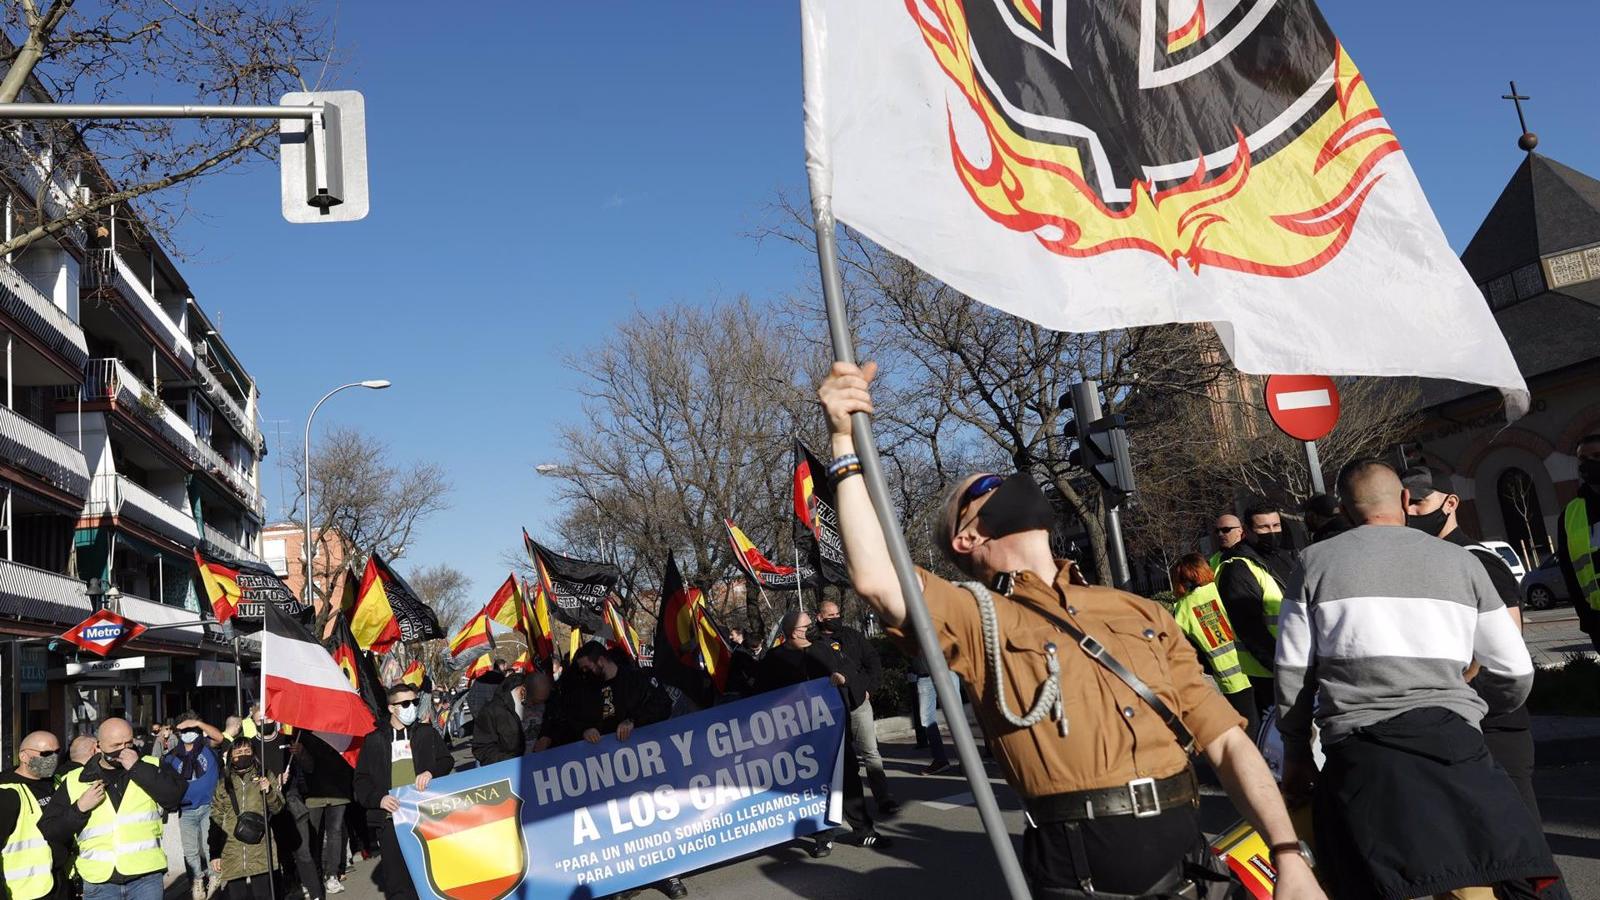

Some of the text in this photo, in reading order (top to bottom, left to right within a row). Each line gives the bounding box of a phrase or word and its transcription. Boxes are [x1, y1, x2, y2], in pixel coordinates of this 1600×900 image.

[86, 628, 121, 639] Metro
[533, 696, 836, 805] HONOR Y GLORIA
[431, 787, 500, 816] ESPAÑA
[573, 744, 819, 846] A LOS CAÍDOS
[602, 844, 620, 861] UN
[624, 831, 672, 854] MUNDO
[675, 811, 733, 840] SOMBRÍO
[736, 793, 800, 822] LLEVAMOS
[804, 789, 818, 802] EL
[577, 865, 614, 885] PARA
[616, 858, 635, 874] UN
[639, 847, 676, 868] CIELO
[678, 833, 717, 856] VACÍO
[720, 814, 785, 843] LLEVAMOS
[788, 811, 796, 822] A
